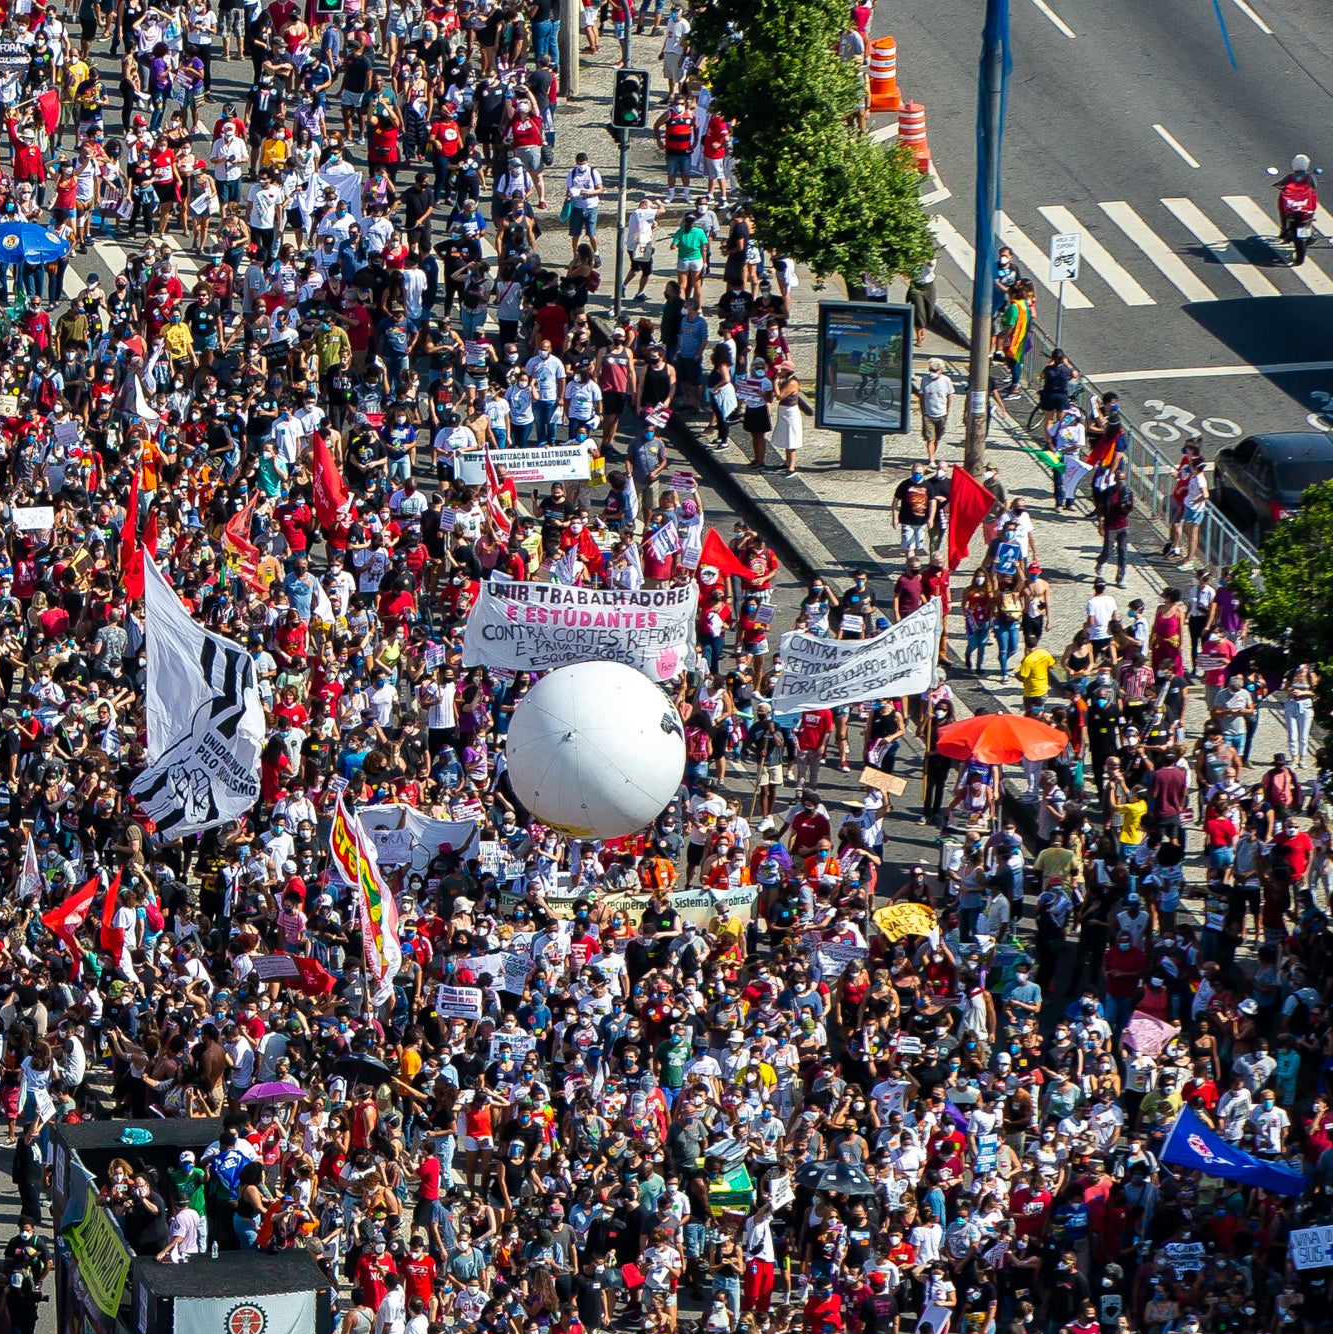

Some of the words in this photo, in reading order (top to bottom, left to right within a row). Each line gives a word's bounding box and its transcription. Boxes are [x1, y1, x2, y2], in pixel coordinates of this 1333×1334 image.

[487, 449, 531, 463] RIVATIZAÇÃO
[487, 581, 530, 602] UNIR
[535, 584, 691, 607] TRABALHADORES
[507, 605, 519, 622] E
[482, 624, 546, 642] CONTRA
[790, 636, 838, 661] CONTRA
[780, 675, 817, 695] FORA
[889, 638, 929, 670] MOURÃO
[194, 744, 219, 771] PELO
[676, 897, 709, 909] Sistema
[1298, 1246, 1325, 1264] SUS
